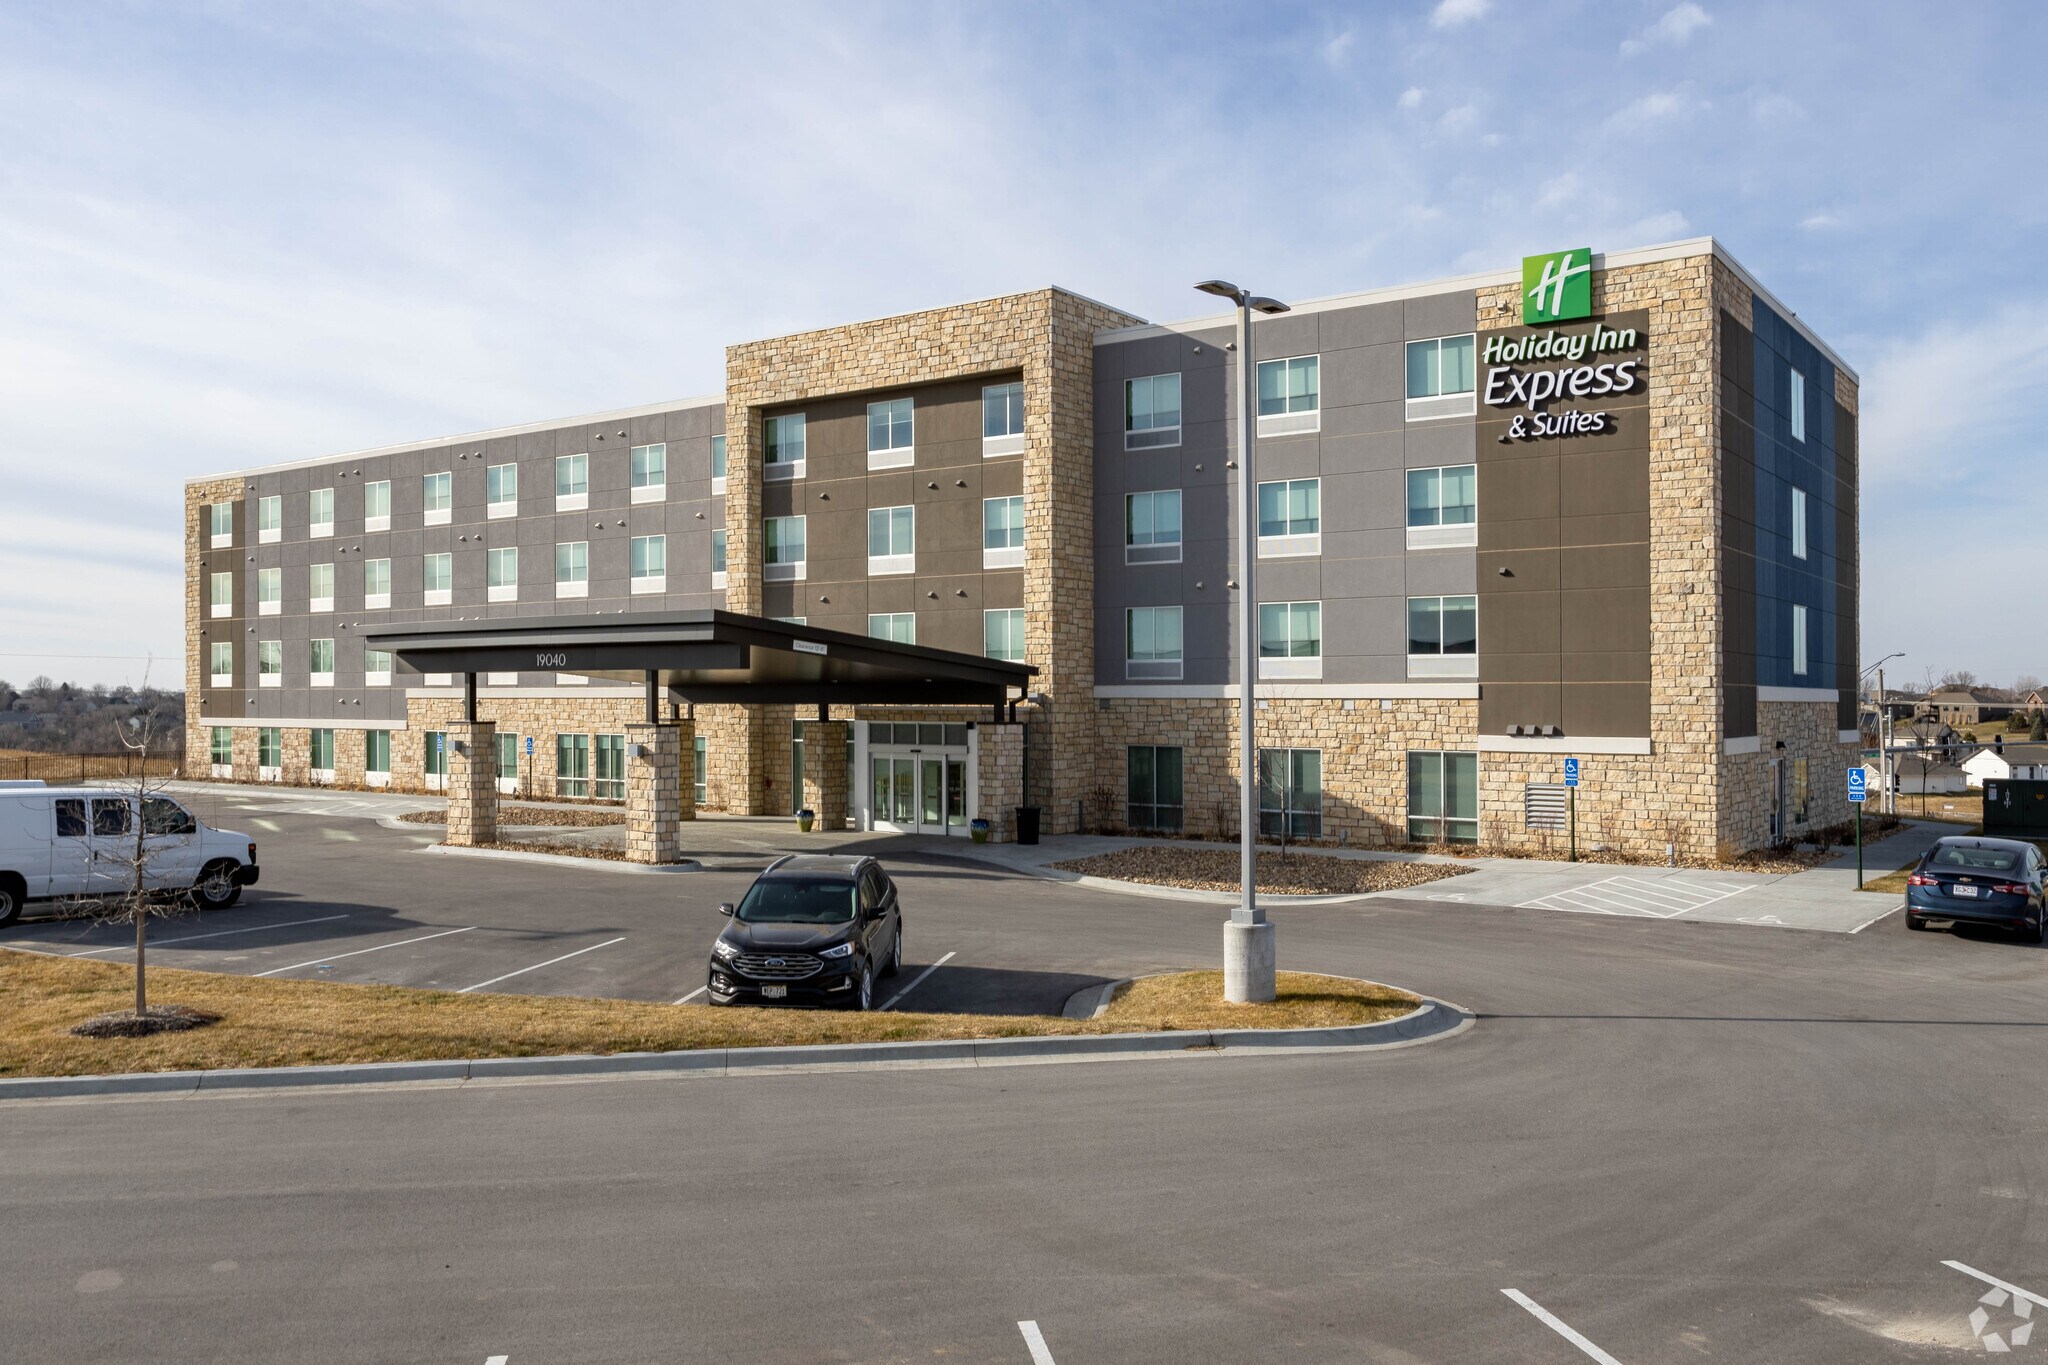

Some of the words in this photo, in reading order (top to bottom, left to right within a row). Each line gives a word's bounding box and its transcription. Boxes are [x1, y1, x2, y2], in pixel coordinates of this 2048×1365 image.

[1482, 330, 1588, 364] Holiday
[1591, 323, 1636, 352] Inn
[1483, 361, 1637, 411] Express
[1508, 414, 1527, 438] &
[1531, 409, 1606, 436] Suites
[536, 653, 567, 667] 19040
